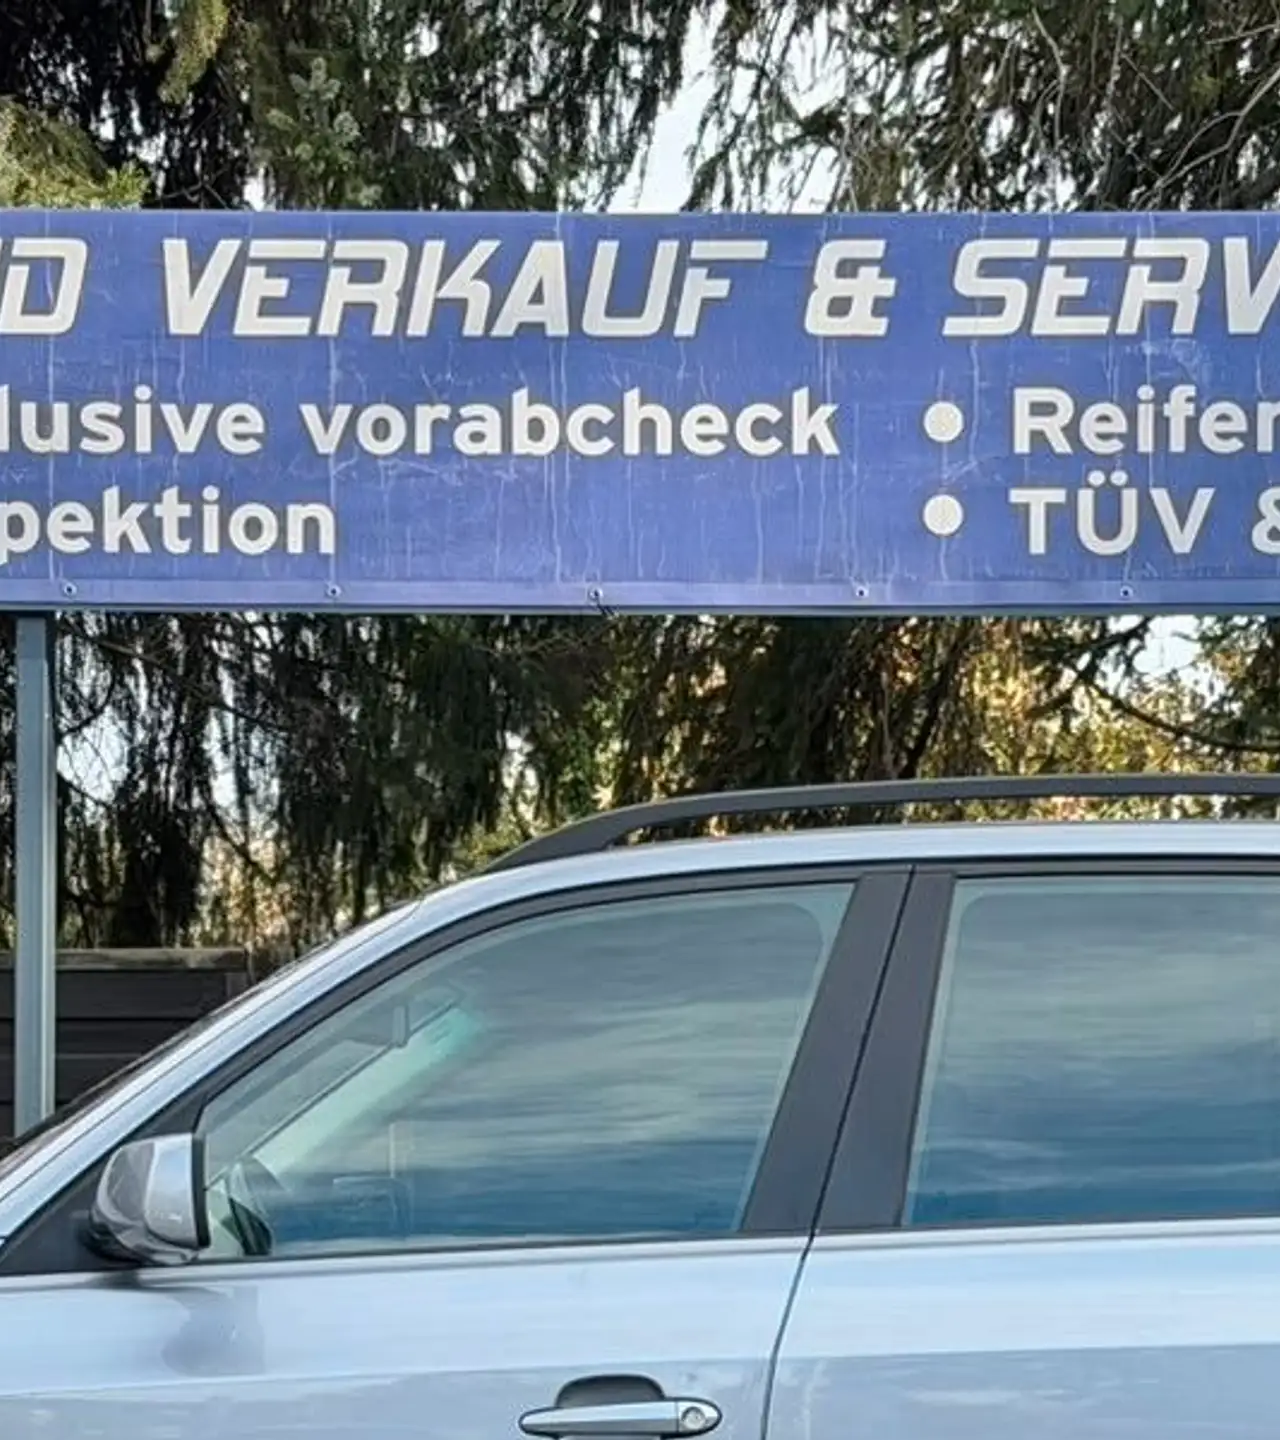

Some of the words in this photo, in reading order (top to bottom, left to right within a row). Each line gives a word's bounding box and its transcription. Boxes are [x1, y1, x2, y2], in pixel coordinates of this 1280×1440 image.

[162, 237, 768, 337] VERKAUF
[804, 238, 897, 337] &
[299, 386, 841, 457] vorabcheck
[1008, 469, 1215, 556] TÜV
